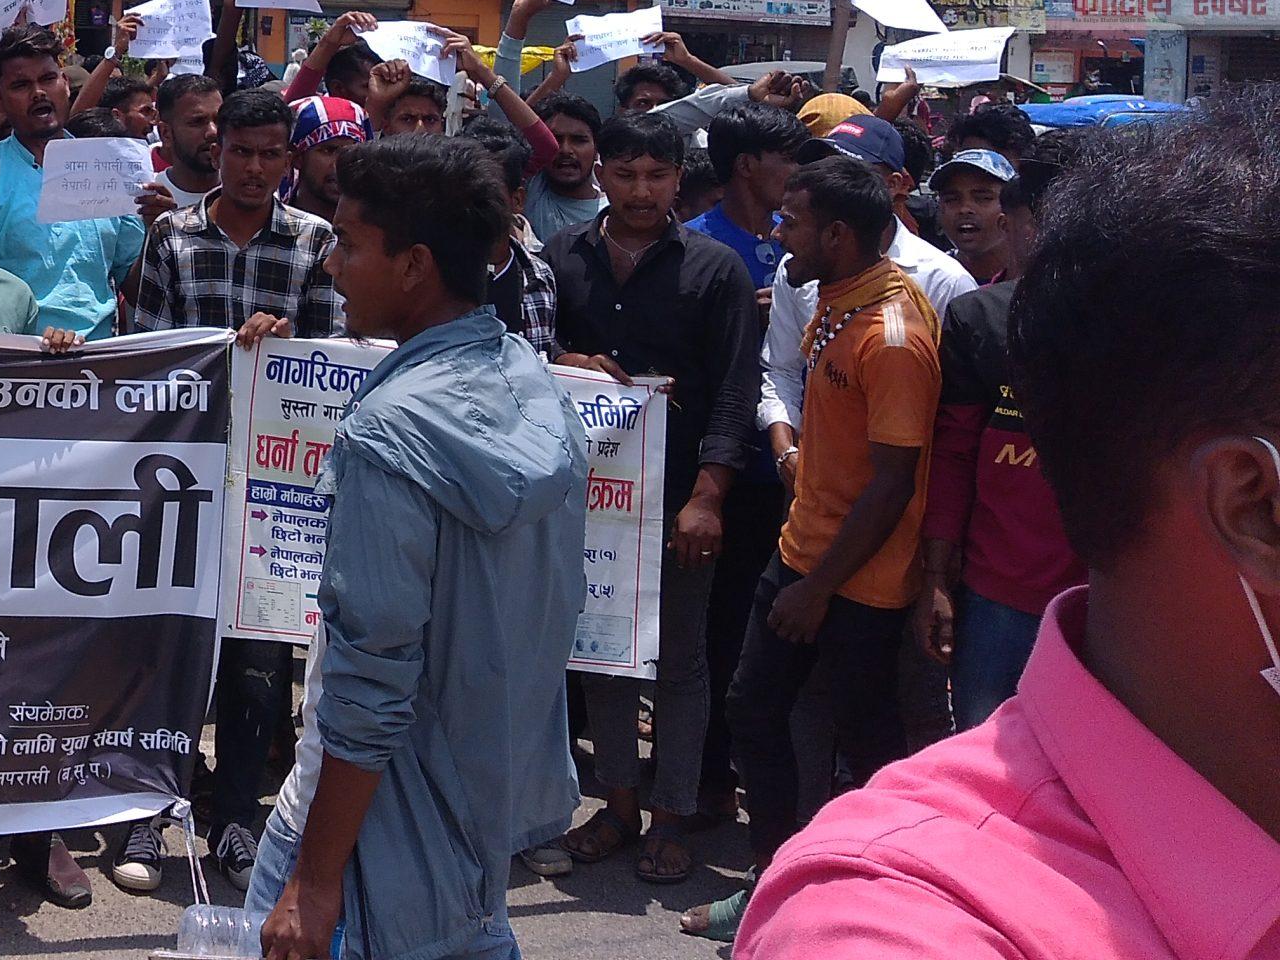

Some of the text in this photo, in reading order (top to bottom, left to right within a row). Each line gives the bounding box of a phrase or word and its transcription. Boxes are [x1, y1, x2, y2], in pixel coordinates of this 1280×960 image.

[94, 158, 122, 174] नेपाली
[114, 368, 212, 414] लागि
[577, 394, 643, 431] समिति
[280, 398, 318, 421] सुस्ता
[597, 437, 621, 458] प्रदेश
[255, 428, 300, 474] धर्ना
[250, 484, 278, 502] हाम्रो
[270, 524, 302, 543] छिटो
[270, 544, 323, 565] नेपालको
[269, 562, 298, 580] छिटो
[12, 732, 57, 757] लागि
[61, 734, 90, 757] युवा
[92, 726, 134, 749] संघर्ष
[137, 727, 193, 756] समिति
